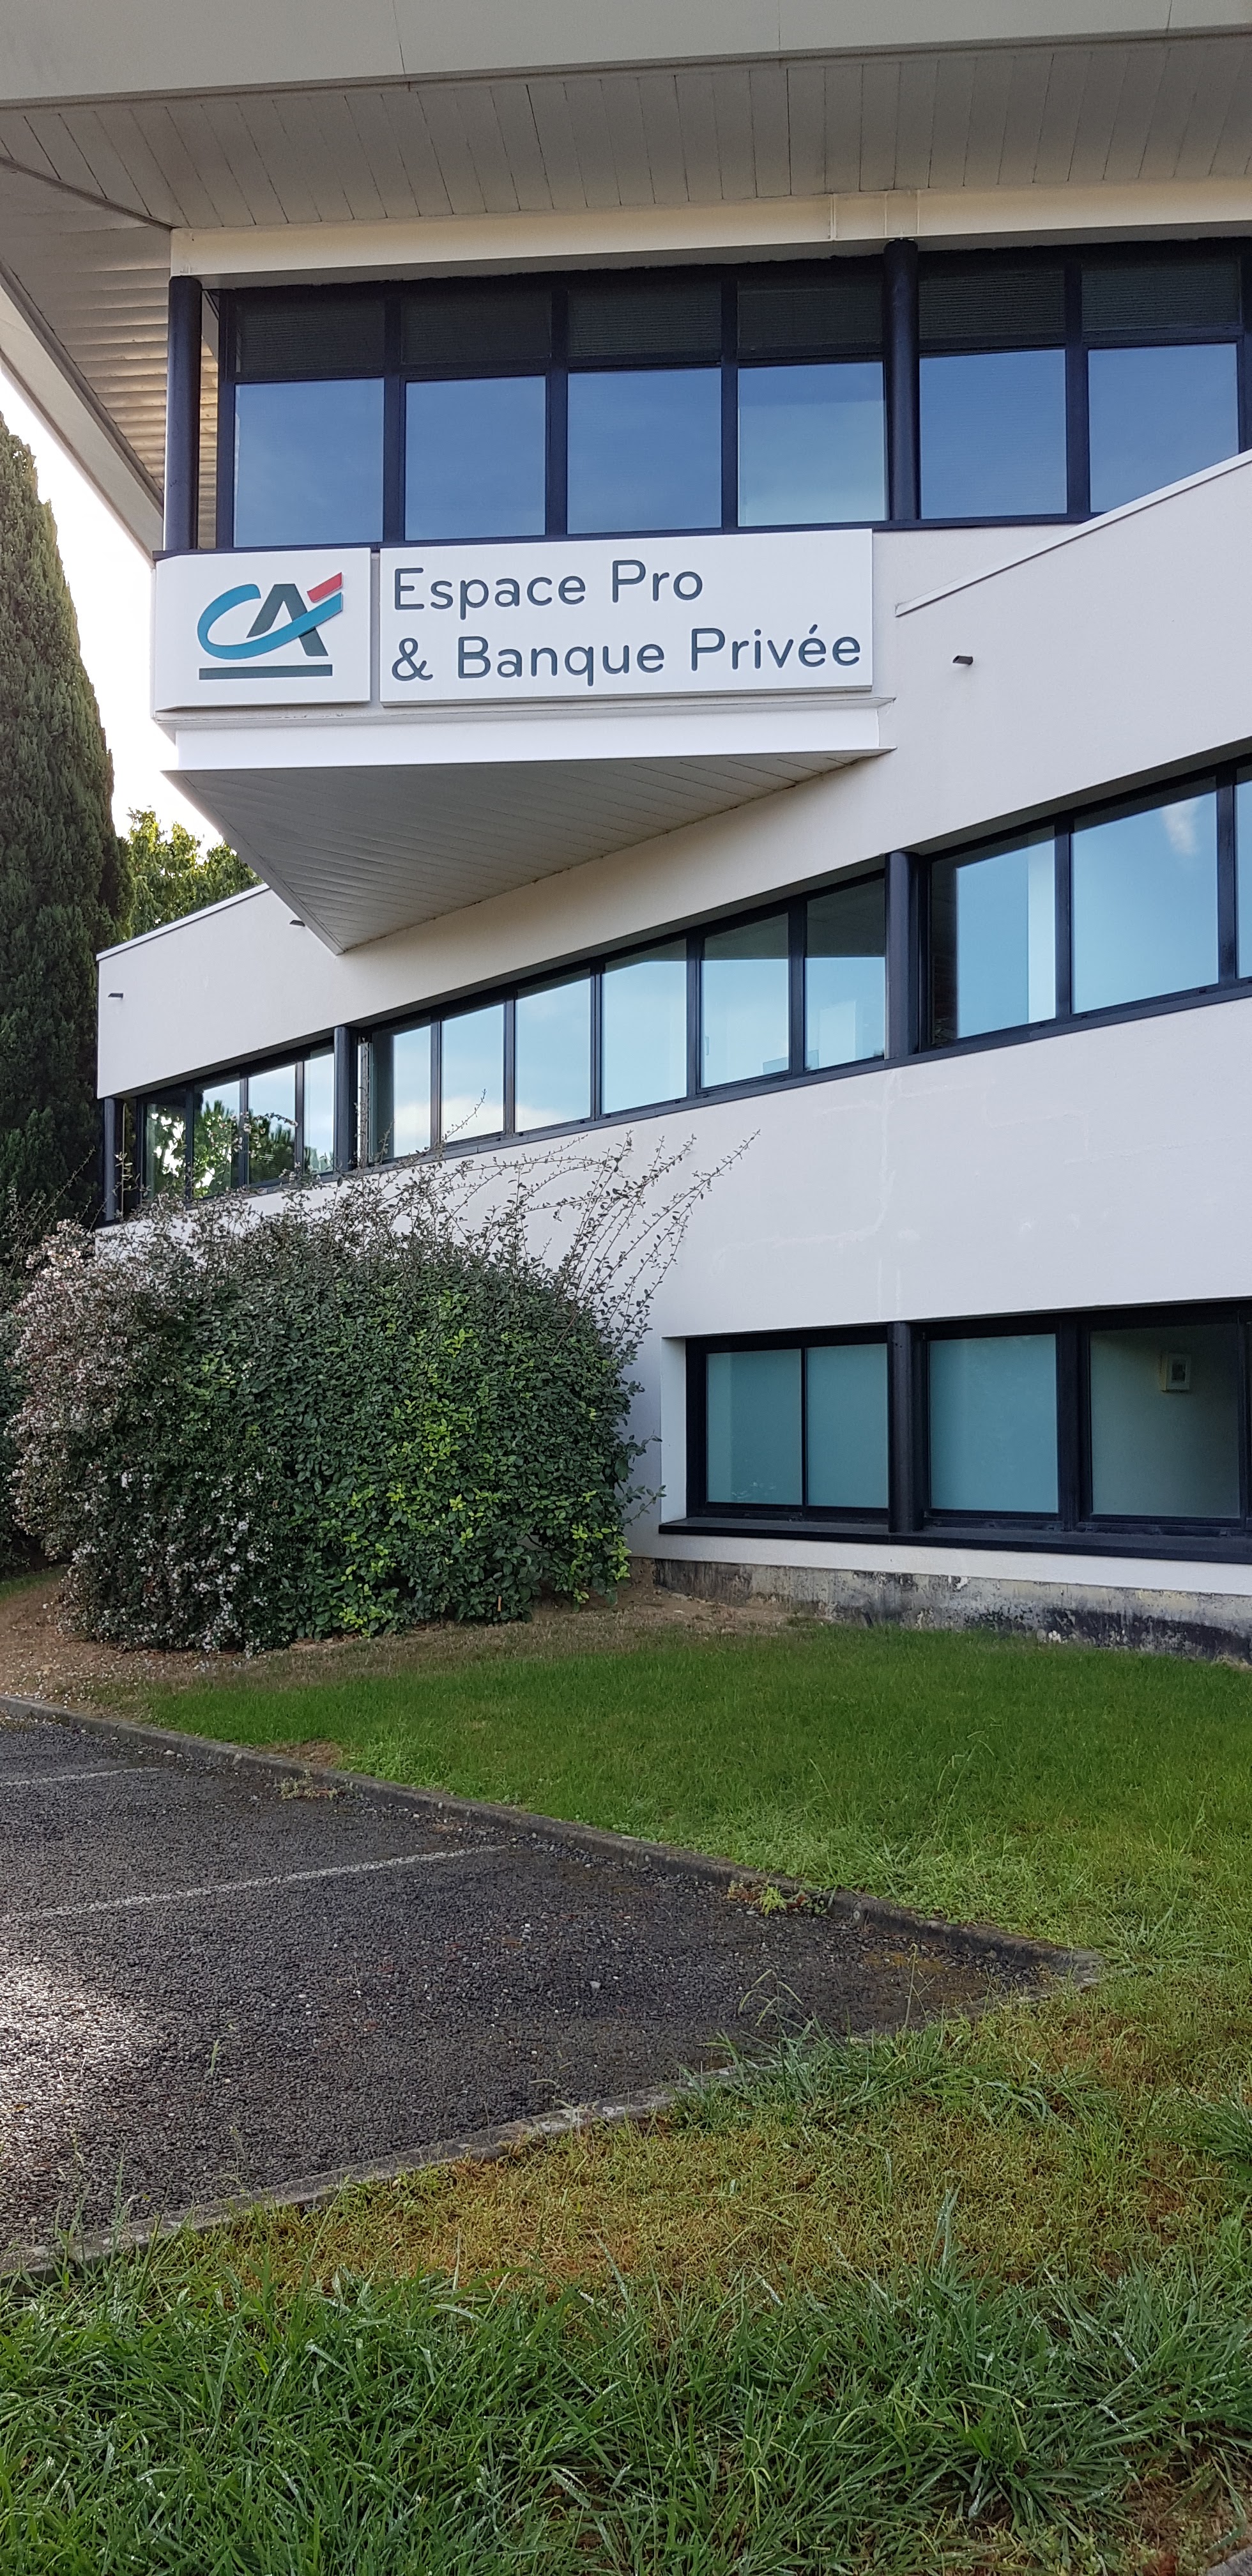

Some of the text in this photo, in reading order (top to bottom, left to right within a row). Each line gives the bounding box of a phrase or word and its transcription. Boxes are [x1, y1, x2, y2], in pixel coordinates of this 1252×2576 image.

[393, 558, 703, 621] Espace Pro
[391, 623, 861, 687] & Banque Privée
